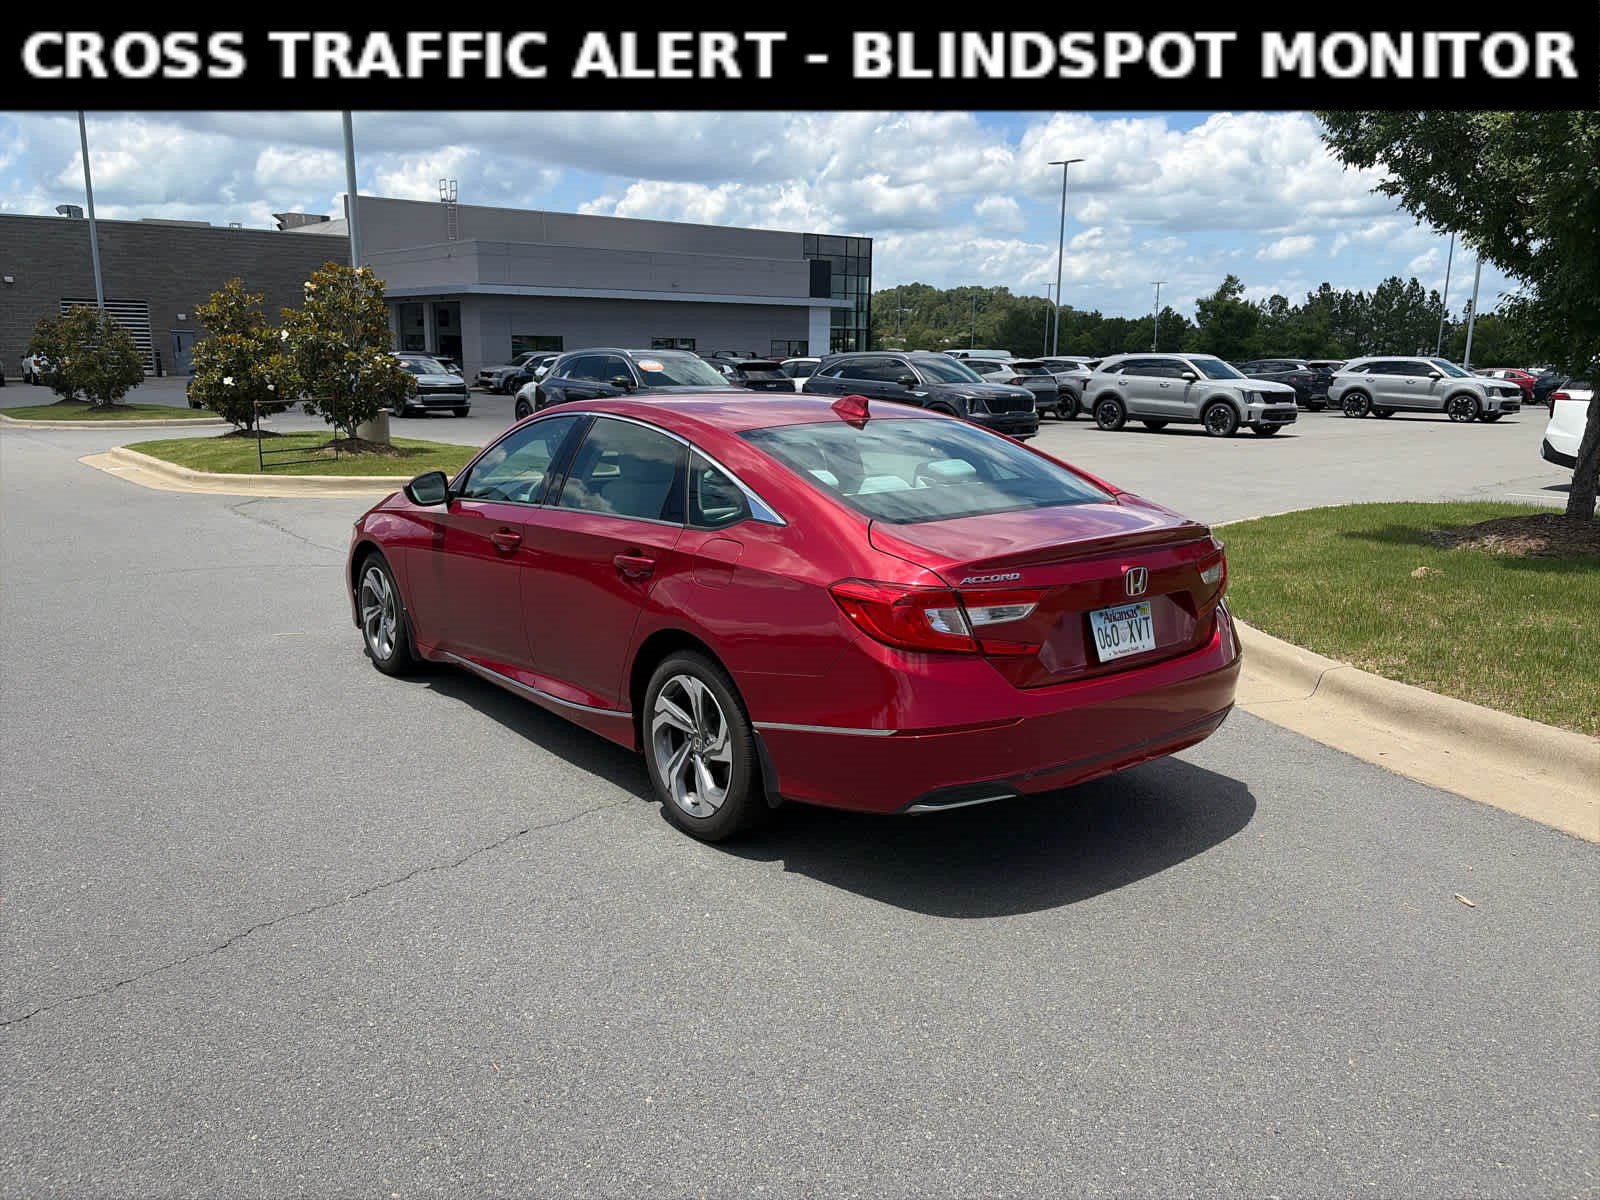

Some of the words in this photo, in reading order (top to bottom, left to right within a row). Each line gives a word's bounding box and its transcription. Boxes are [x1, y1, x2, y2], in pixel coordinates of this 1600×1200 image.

[960, 573, 1020, 585] ACCORD
[1103, 608, 1138, 624] Arkansas
[1097, 623, 1120, 649] 060
[1127, 616, 1151, 644] XVT
